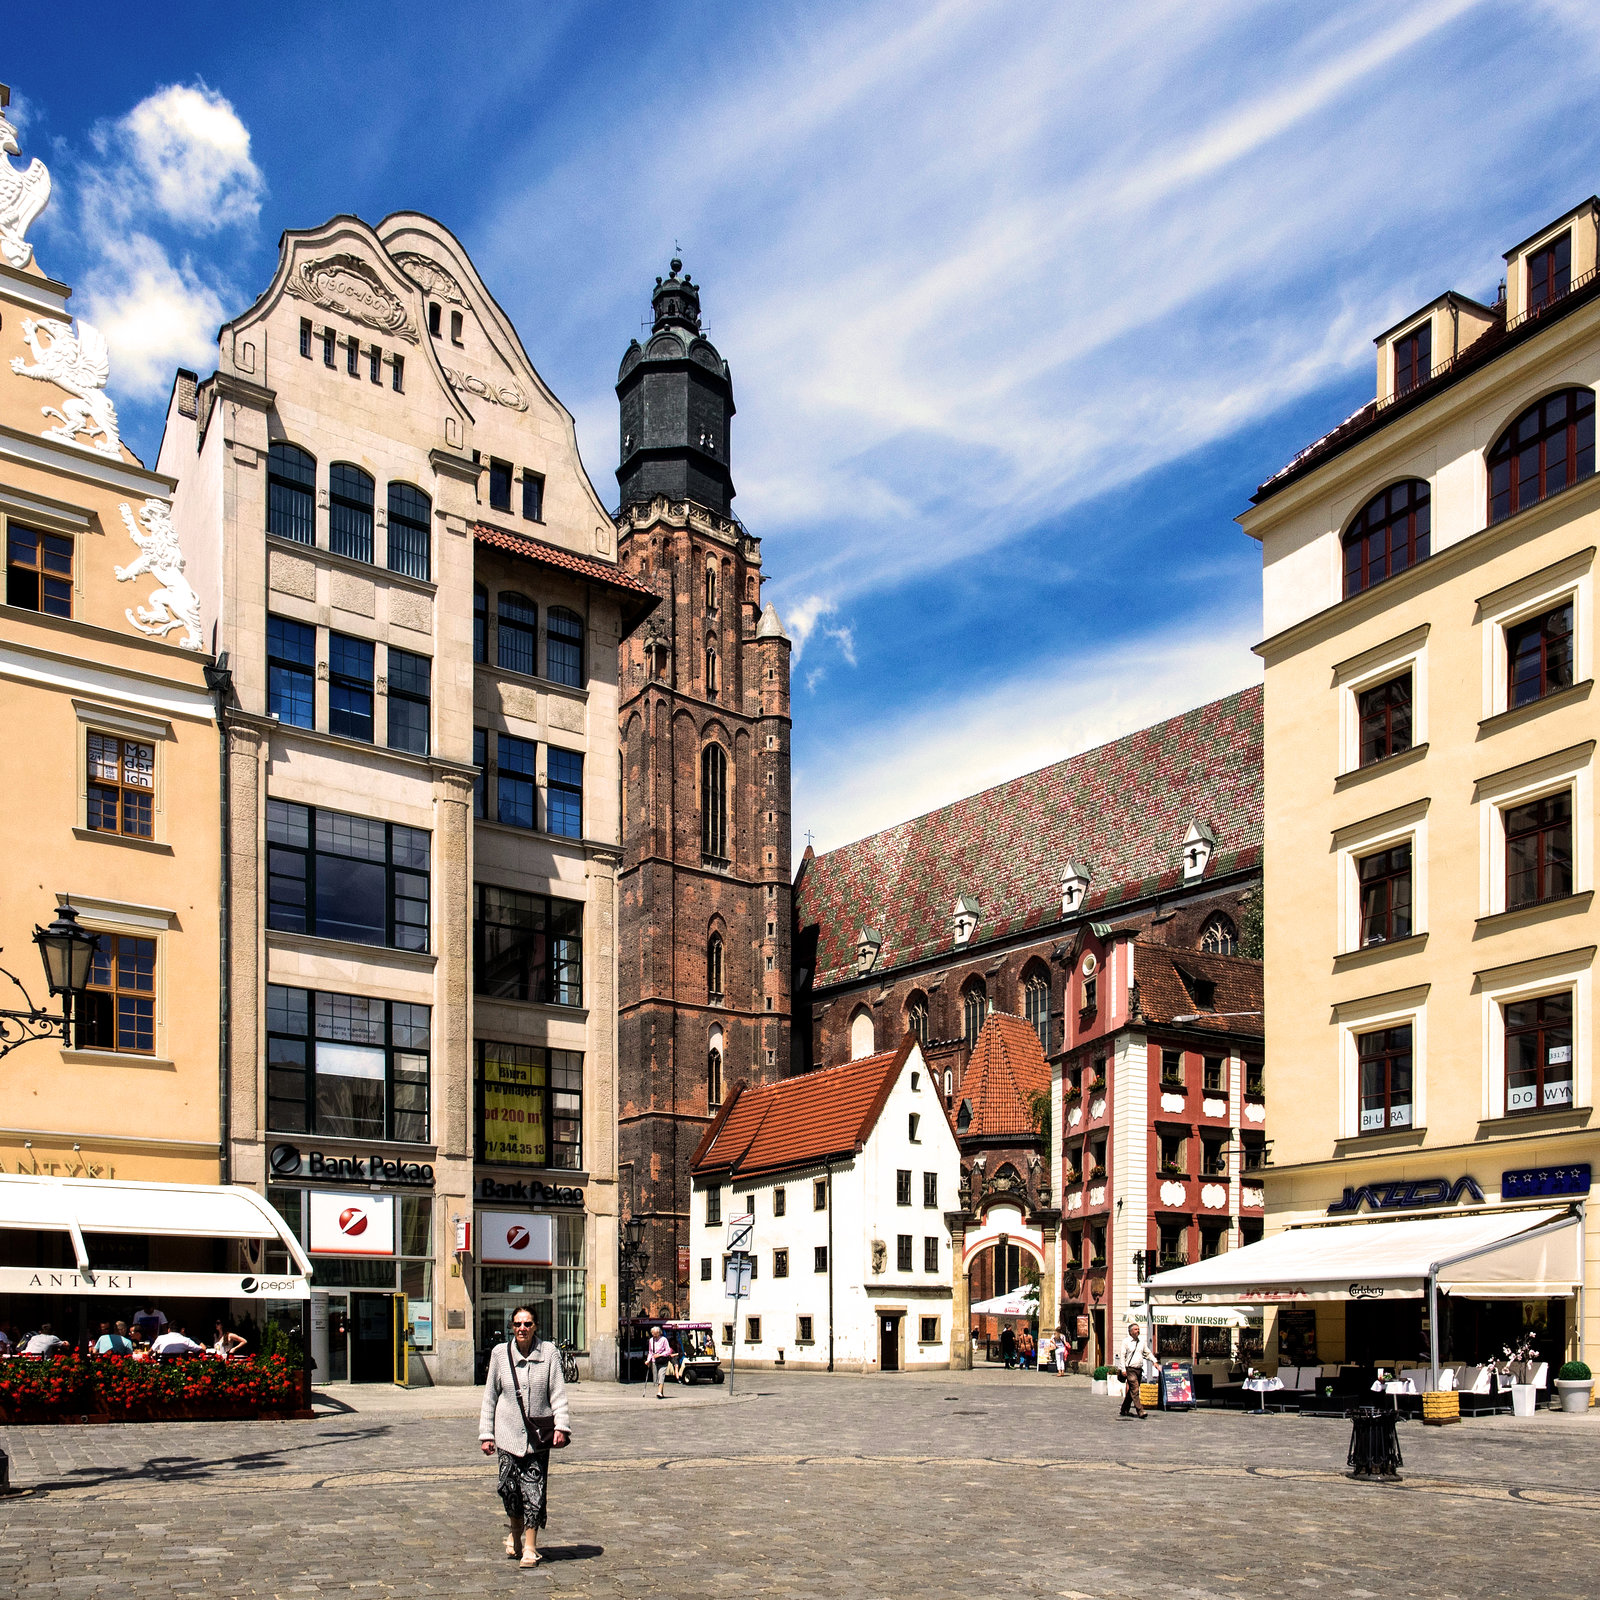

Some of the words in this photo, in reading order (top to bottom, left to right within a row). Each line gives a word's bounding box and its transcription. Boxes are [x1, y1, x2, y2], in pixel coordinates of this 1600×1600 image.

[499, 1067, 527, 1080] Biura
[501, 1108, 525, 1123] 200
[500, 1142, 518, 1153] 344
[520, 1144, 532, 1154] 35
[309, 1151, 365, 1176] Bank
[370, 1155, 434, 1179] Pekao
[482, 1178, 528, 1199] Bank
[530, 1181, 584, 1202] Pekao
[29, 1274, 133, 1288] ANTYKI
[261, 1280, 295, 1291] pepsi
[1175, 1290, 1202, 1303] Carlsberg
[1349, 1284, 1384, 1299] Carlsberg
[1135, 1314, 1169, 1324] SOMRSBY
[1184, 1315, 1229, 1325] SOMERSBY
